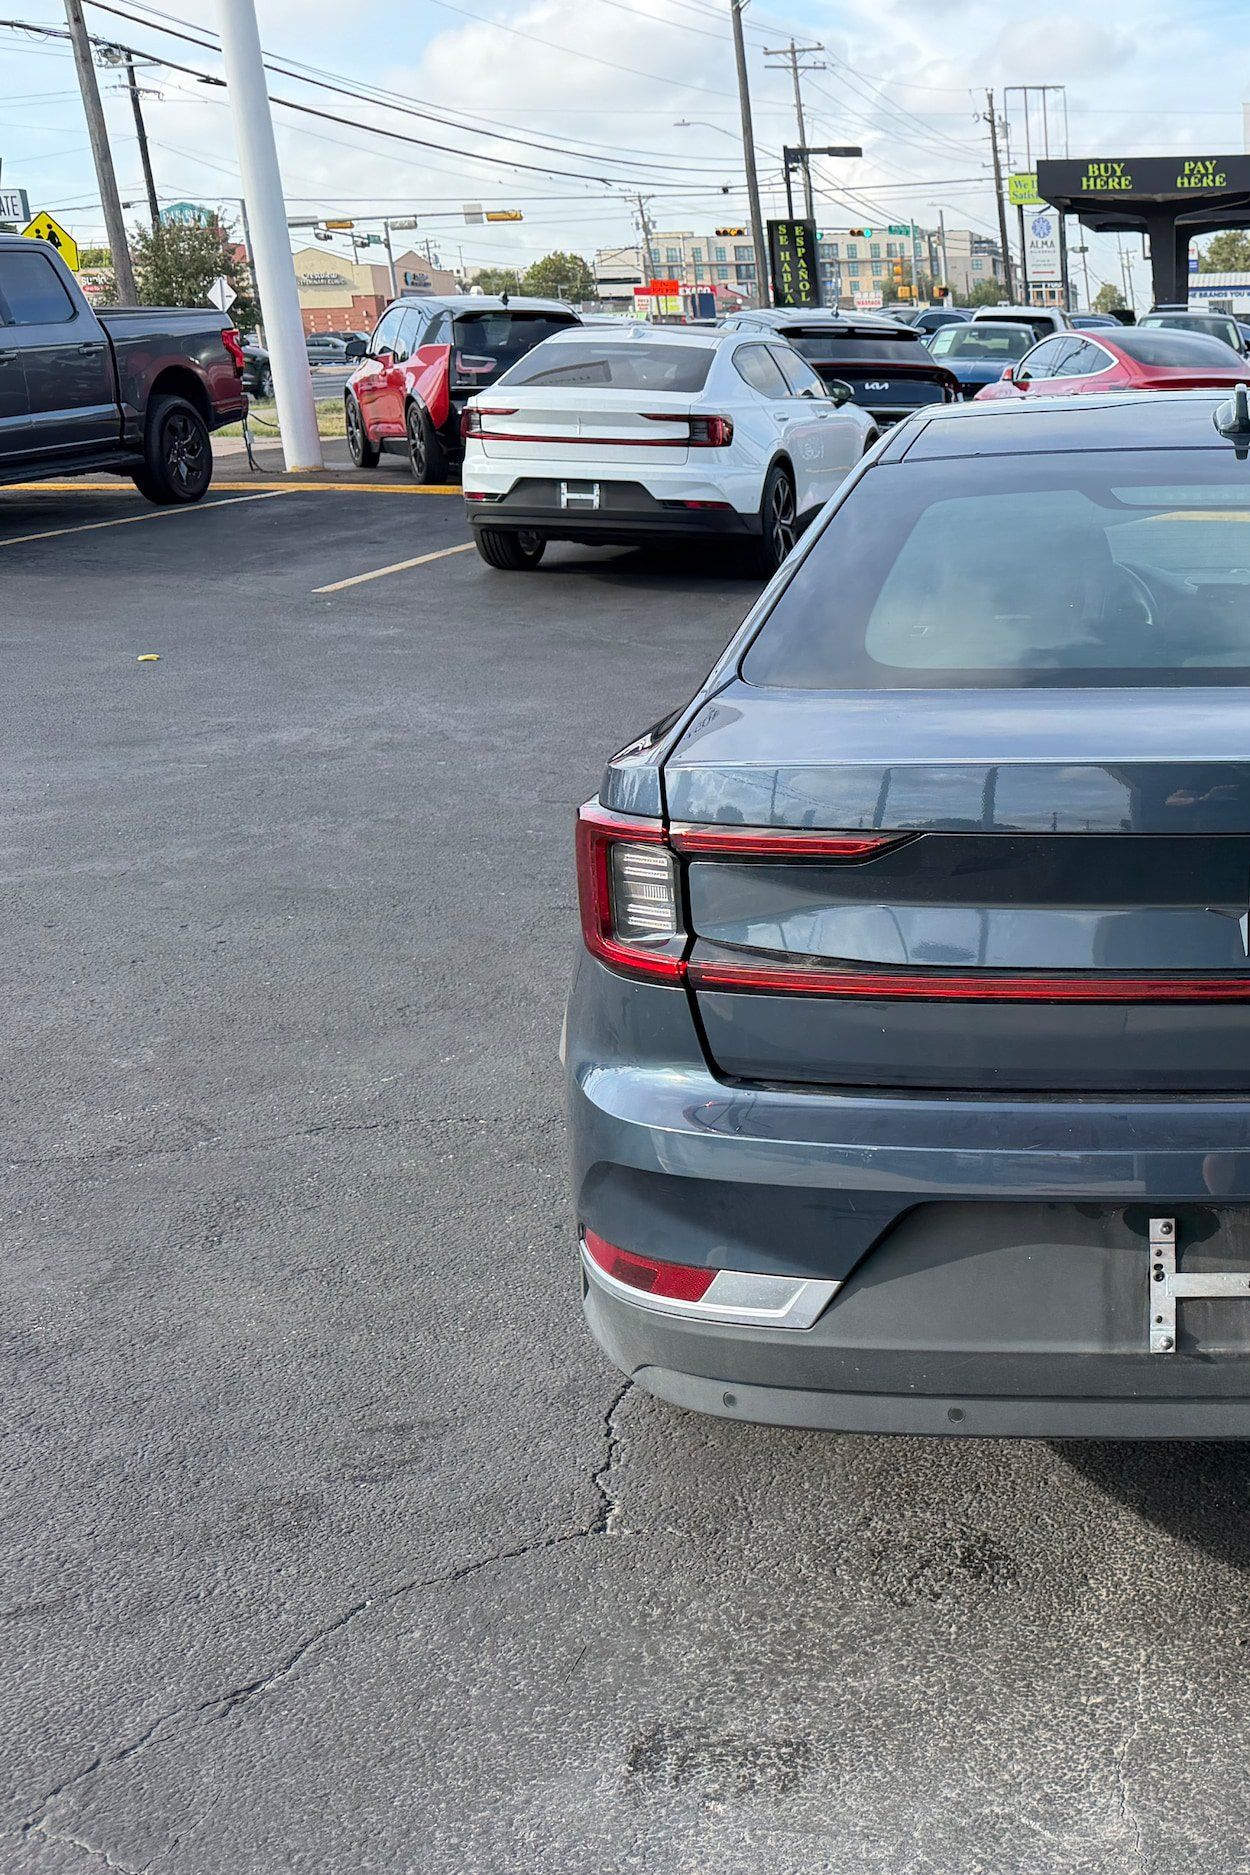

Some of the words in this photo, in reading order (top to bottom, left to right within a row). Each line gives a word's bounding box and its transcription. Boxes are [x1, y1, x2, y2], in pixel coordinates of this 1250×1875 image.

[1088, 163, 1125, 177] BUY
[1184, 160, 1217, 175] PAY
[1014, 180, 1028, 189] We
[1081, 175, 1133, 191] HERE
[1176, 173, 1226, 188] HERE
[1012, 190, 1038, 200] Satis
[778, 224, 789, 245] SE
[1030, 240, 1056, 249] ALMA
[780, 251, 795, 304] HABLA
[680, 286, 711, 296] EXACO
